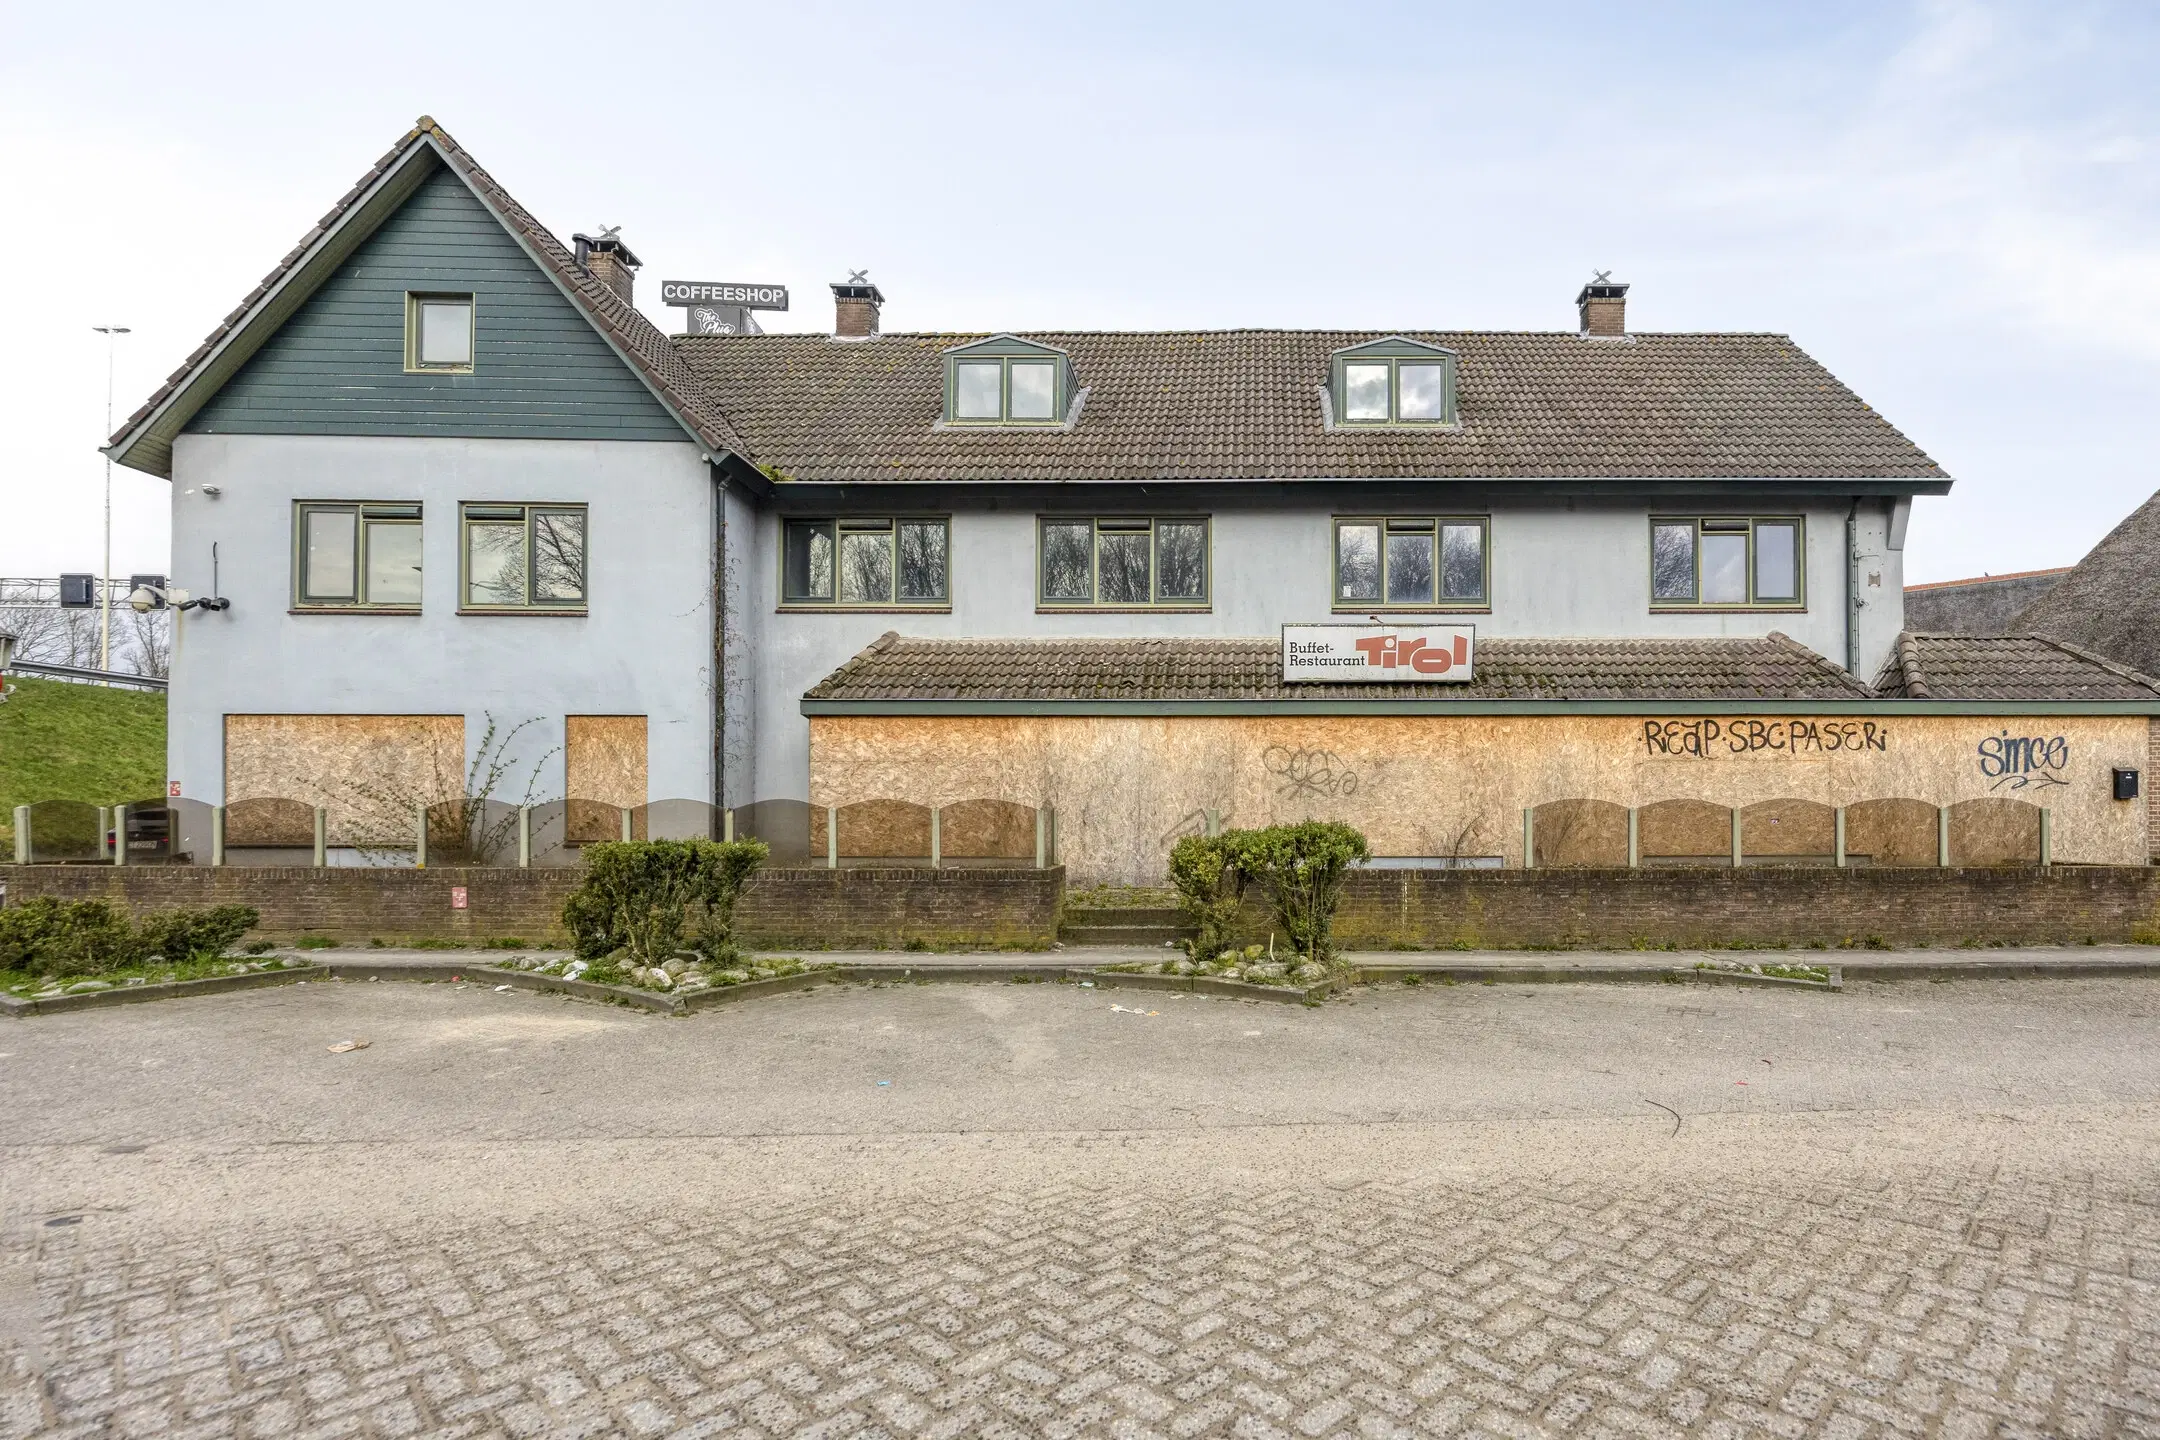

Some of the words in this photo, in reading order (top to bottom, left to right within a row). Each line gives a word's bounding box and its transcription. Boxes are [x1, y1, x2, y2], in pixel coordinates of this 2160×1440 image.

[664, 285, 784, 303] COFFEESHOP
[697, 310, 716, 322] The
[1289, 642, 1334, 653] Buffet-
[1356, 635, 1467, 673] Tirol
[1289, 655, 1365, 666] Restaurant
